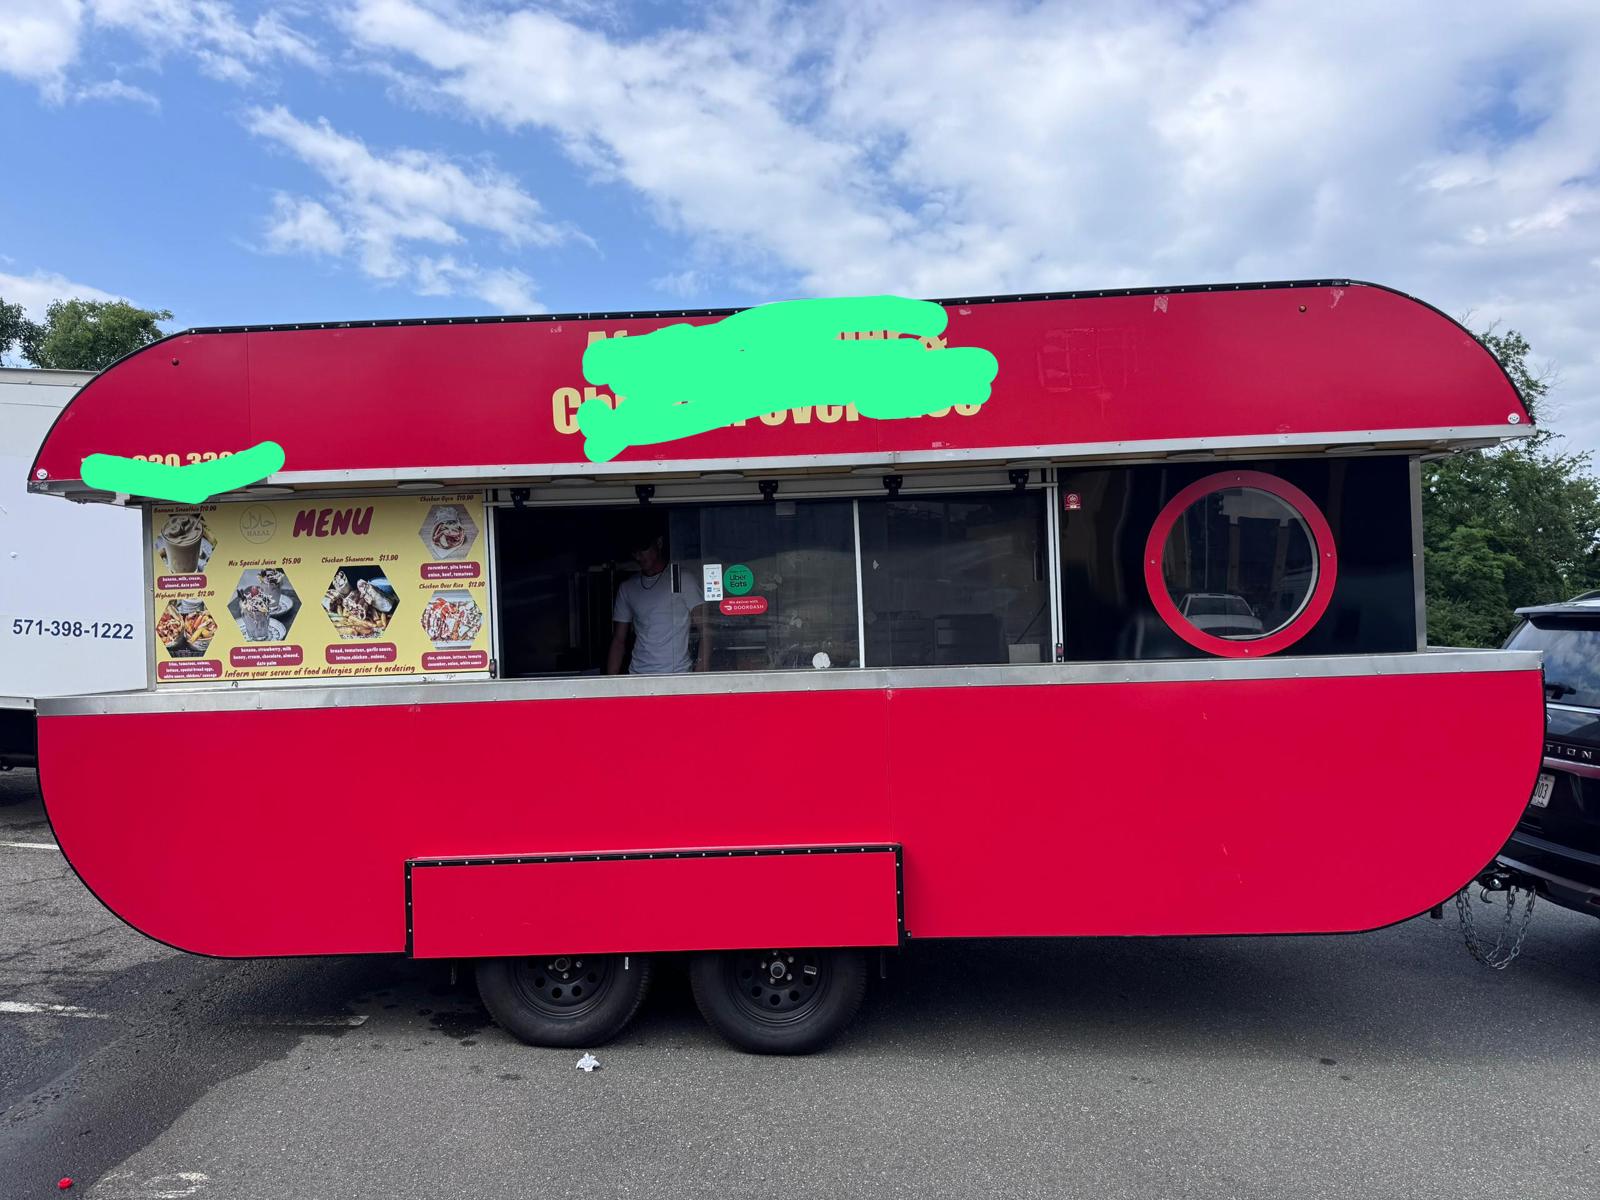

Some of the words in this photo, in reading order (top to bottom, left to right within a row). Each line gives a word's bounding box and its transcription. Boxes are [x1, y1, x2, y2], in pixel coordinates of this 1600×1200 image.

[292, 506, 374, 537] MENU
[282, 557, 302, 565] $15.00
[13, 619, 134, 640] 571-398-1222
[225, 670, 249, 678] Inform
[304, 667, 321, 675] food
[321, 667, 352, 676] allergies
[354, 666, 373, 674] prior
[384, 664, 415, 673] ordering
